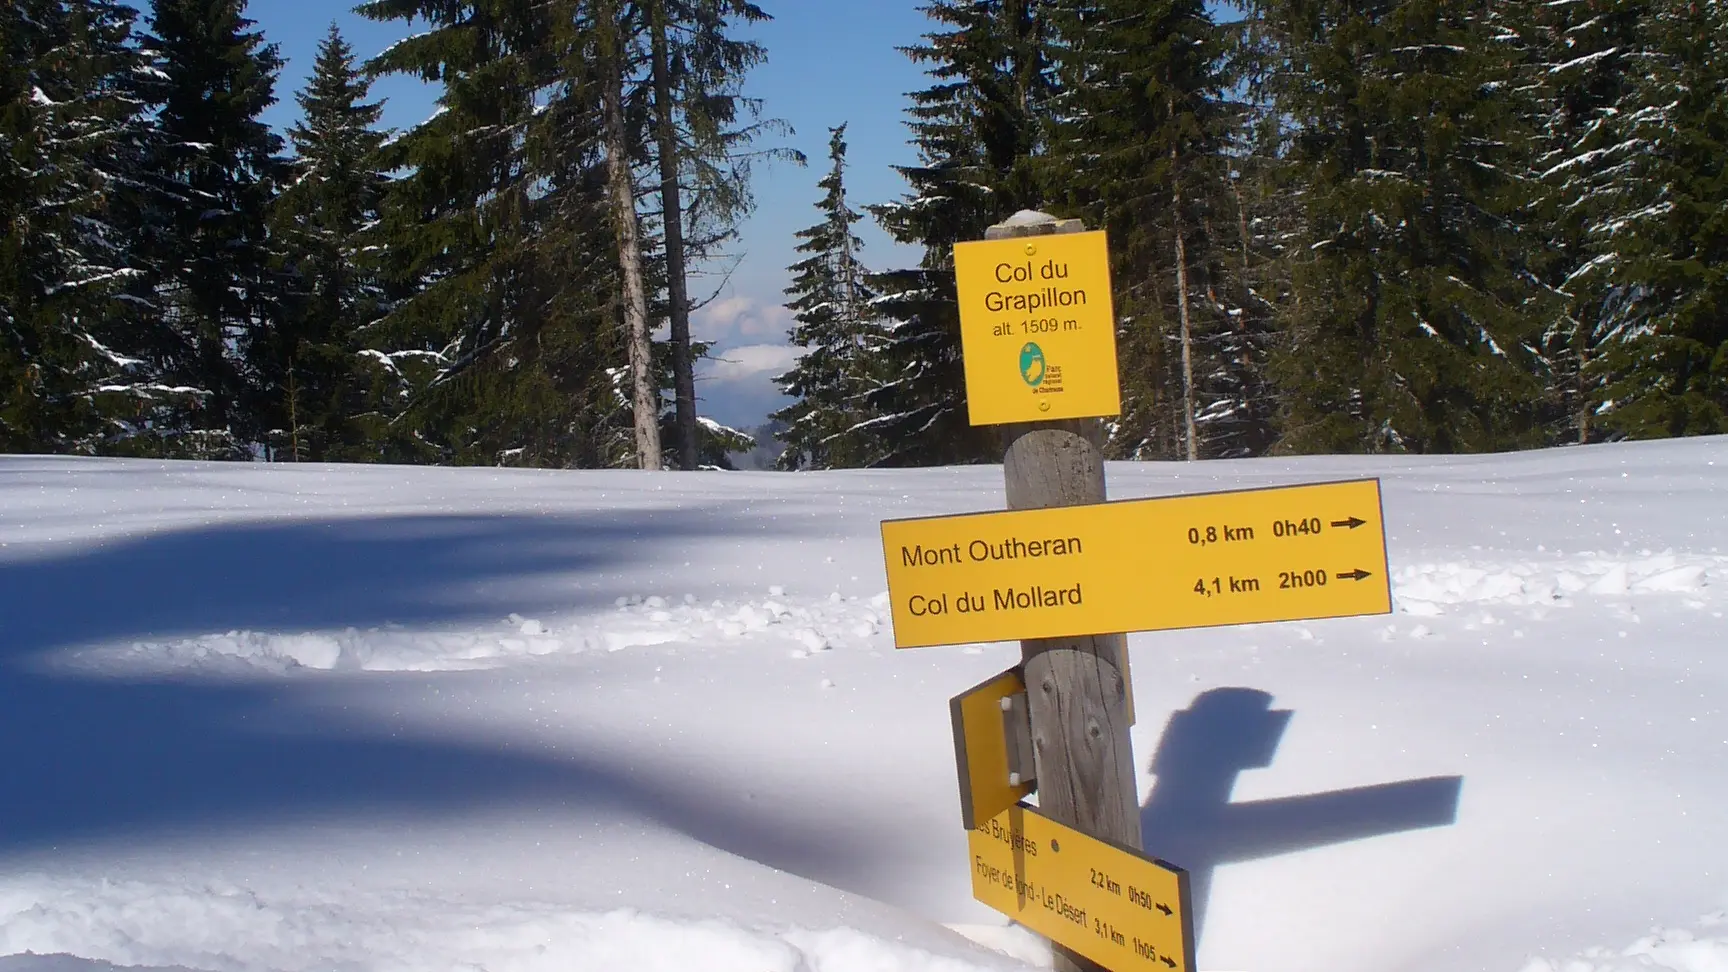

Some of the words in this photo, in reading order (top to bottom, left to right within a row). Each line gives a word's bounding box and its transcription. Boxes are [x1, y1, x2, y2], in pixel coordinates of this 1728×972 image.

[995, 261, 1033, 283] Col
[1040, 259, 1068, 280] du
[985, 288, 1086, 314] Grapillon
[993, 320, 1014, 337] alt.
[1021, 318, 1058, 334] 1509
[1063, 319, 1082, 331] m.
[901, 542, 962, 568] Mont
[968, 534, 1083, 563] Outheran
[1187, 525, 1217, 547] 0,8
[1223, 523, 1255, 543] km
[1272, 517, 1322, 538] 0h40
[908, 593, 948, 617] Col
[956, 590, 985, 613] du
[994, 583, 1083, 611] Mollard
[1193, 576, 1222, 598] 4,1
[1228, 573, 1261, 594] km
[1278, 568, 1327, 590] 2h00
[991, 818, 1038, 857] Bruyères
[1090, 867, 1104, 888] 2,2
[1105, 874, 1121, 896] km
[1128, 885, 1152, 910] 0h50
[975, 854, 1001, 884] Foyer
[1002, 869, 1013, 890] de
[1015, 873, 1034, 901] fond
[1041, 886, 1054, 910] Le
[1056, 892, 1088, 929] Désert
[1094, 917, 1109, 939] 3,1
[1110, 925, 1126, 947] km
[1132, 937, 1156, 963] 1h05
